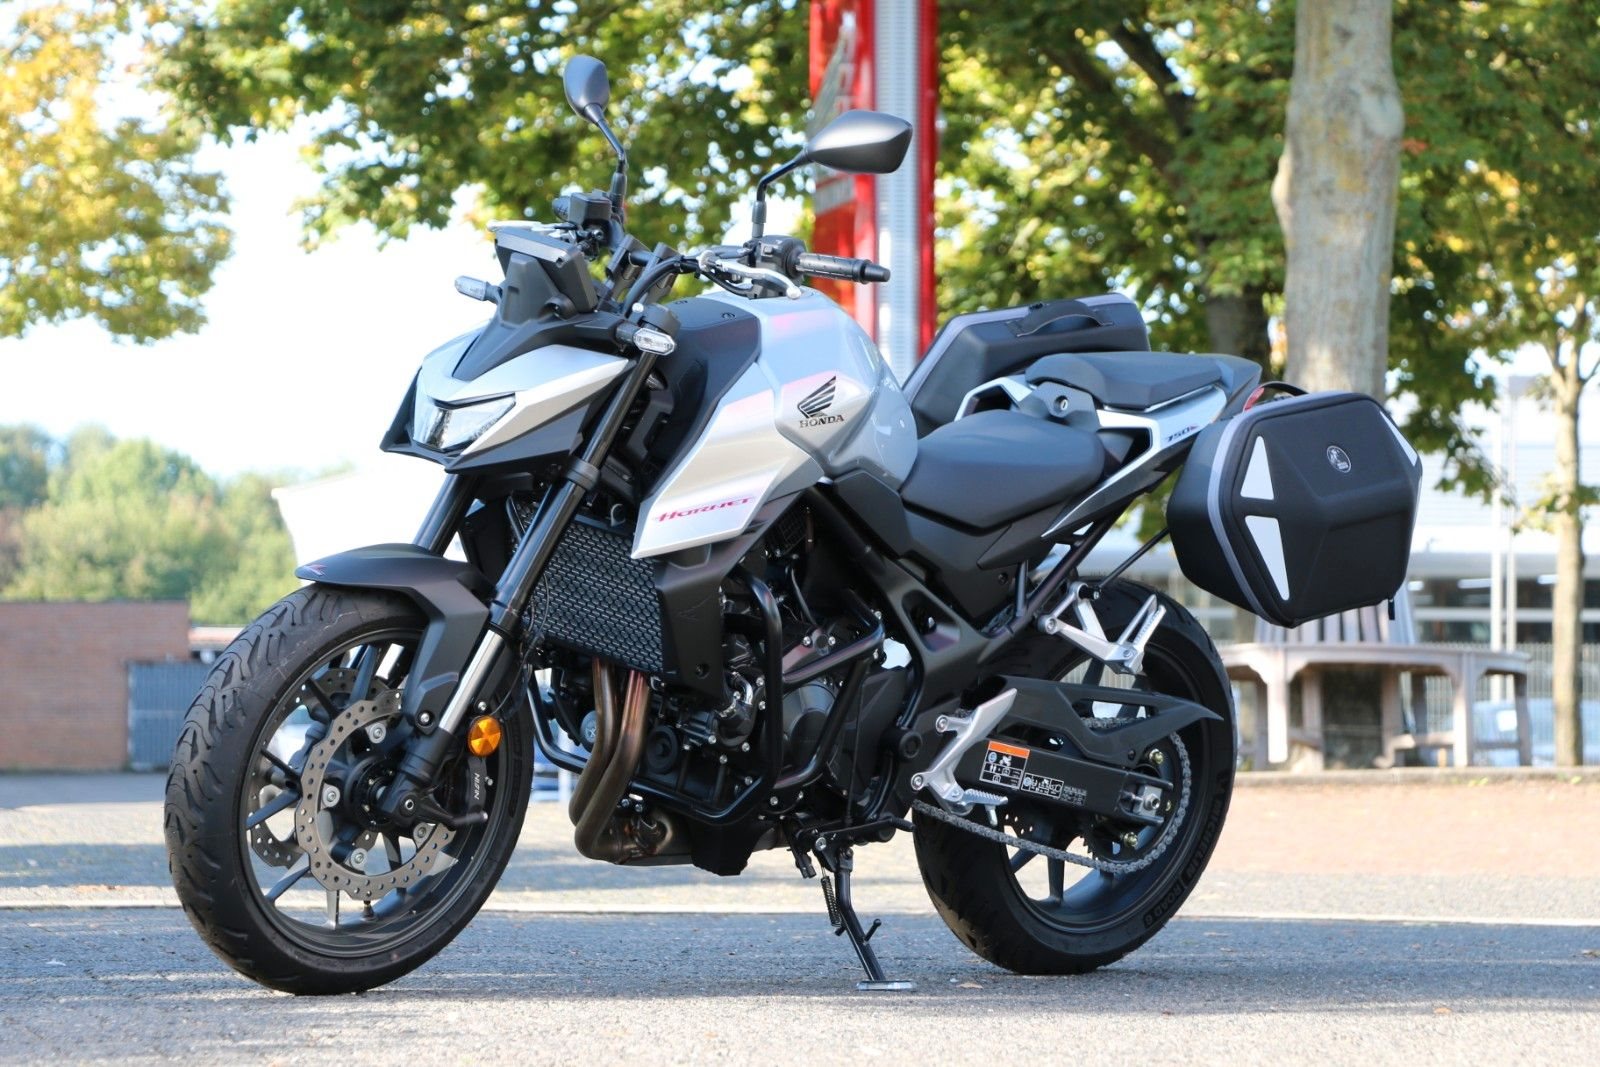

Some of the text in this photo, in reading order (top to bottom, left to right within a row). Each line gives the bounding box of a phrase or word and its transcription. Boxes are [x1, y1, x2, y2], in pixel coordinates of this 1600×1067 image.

[800, 414, 845, 428] HONDA
[1185, 798, 1222, 880] MICHELIN
[1154, 883, 1183, 917] ROAD
